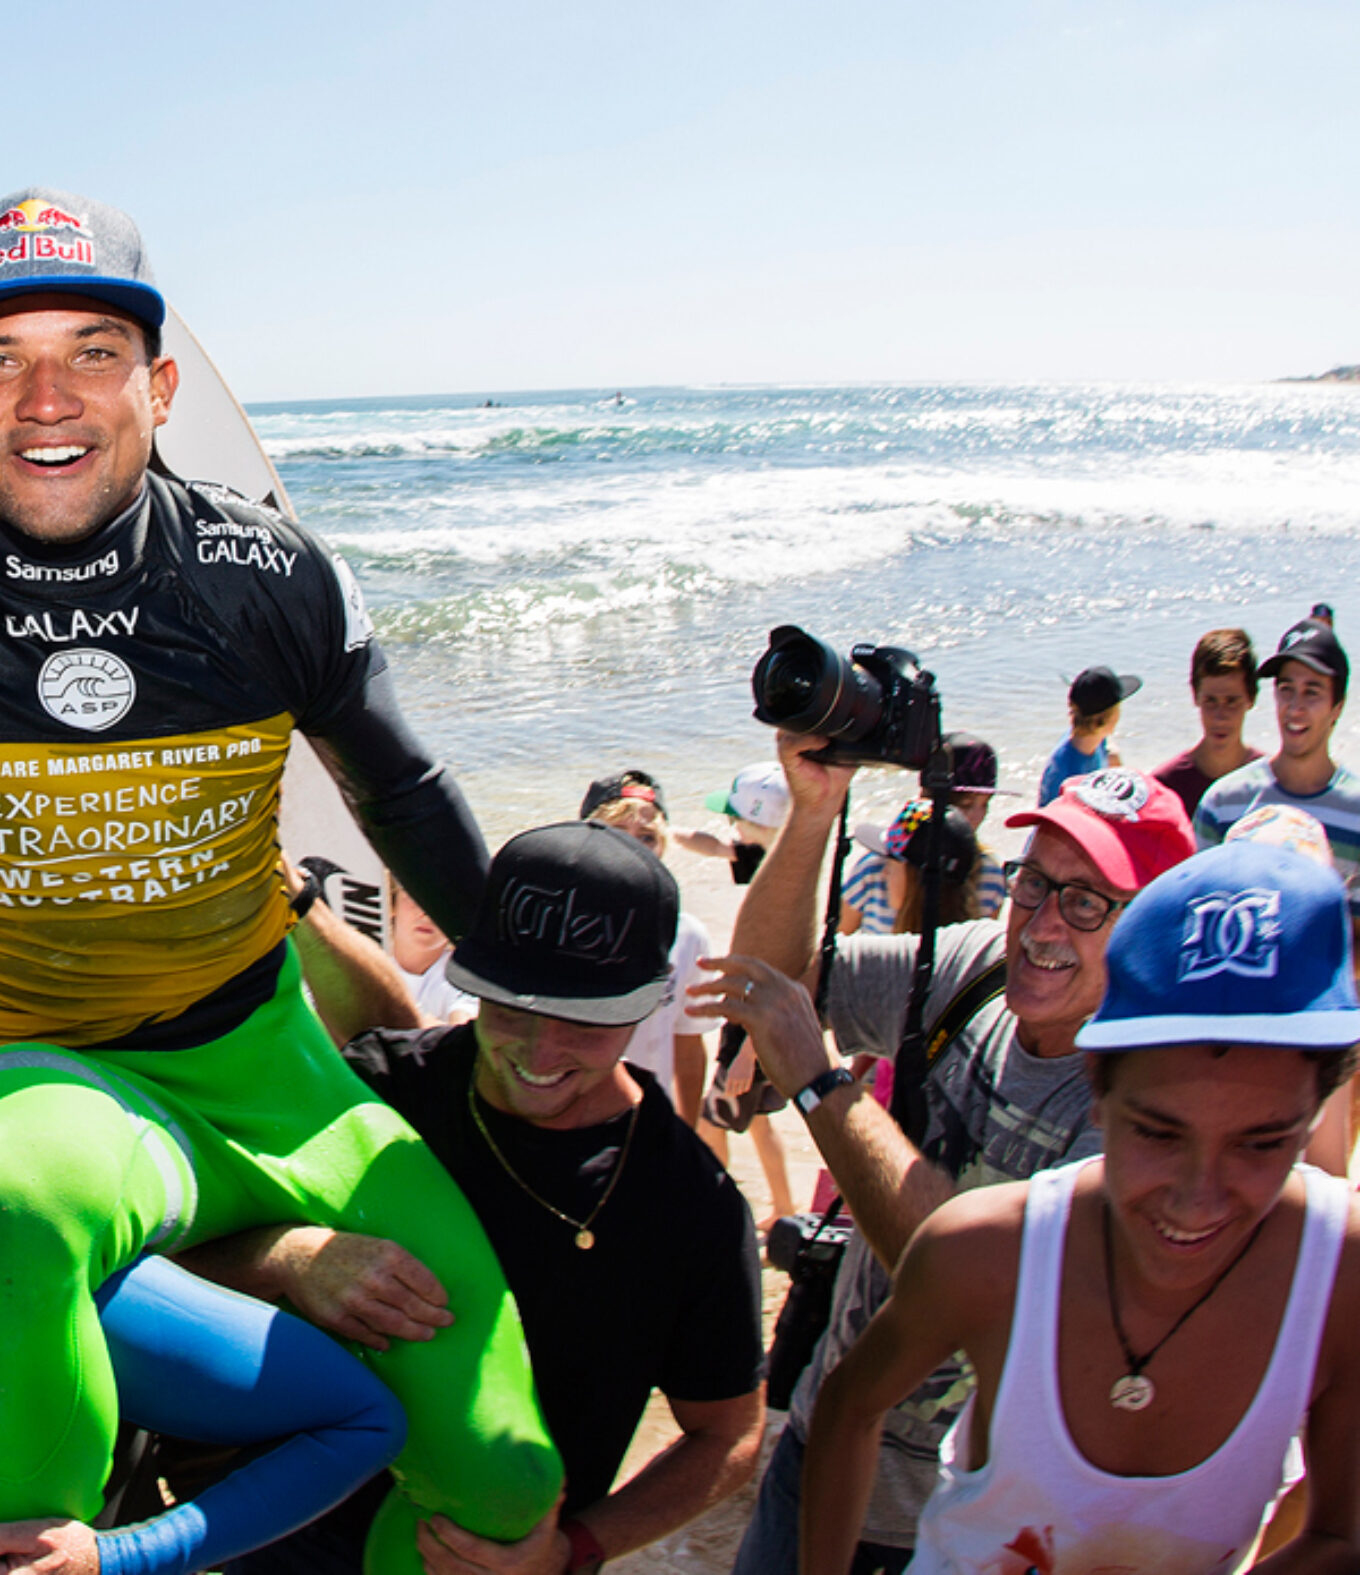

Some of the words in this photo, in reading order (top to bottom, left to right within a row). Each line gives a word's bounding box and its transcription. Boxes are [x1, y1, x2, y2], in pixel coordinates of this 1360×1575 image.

[34, 236, 94, 265] Bull
[195, 518, 273, 545] Samsung
[5, 549, 120, 582] Samsung
[196, 539, 298, 577] GALAXY
[5, 606, 140, 643] GALAXY
[60, 701, 119, 715] ASP
[47, 751, 156, 777] MARGARET
[161, 744, 221, 767] RIVER
[225, 736, 262, 760] PRO
